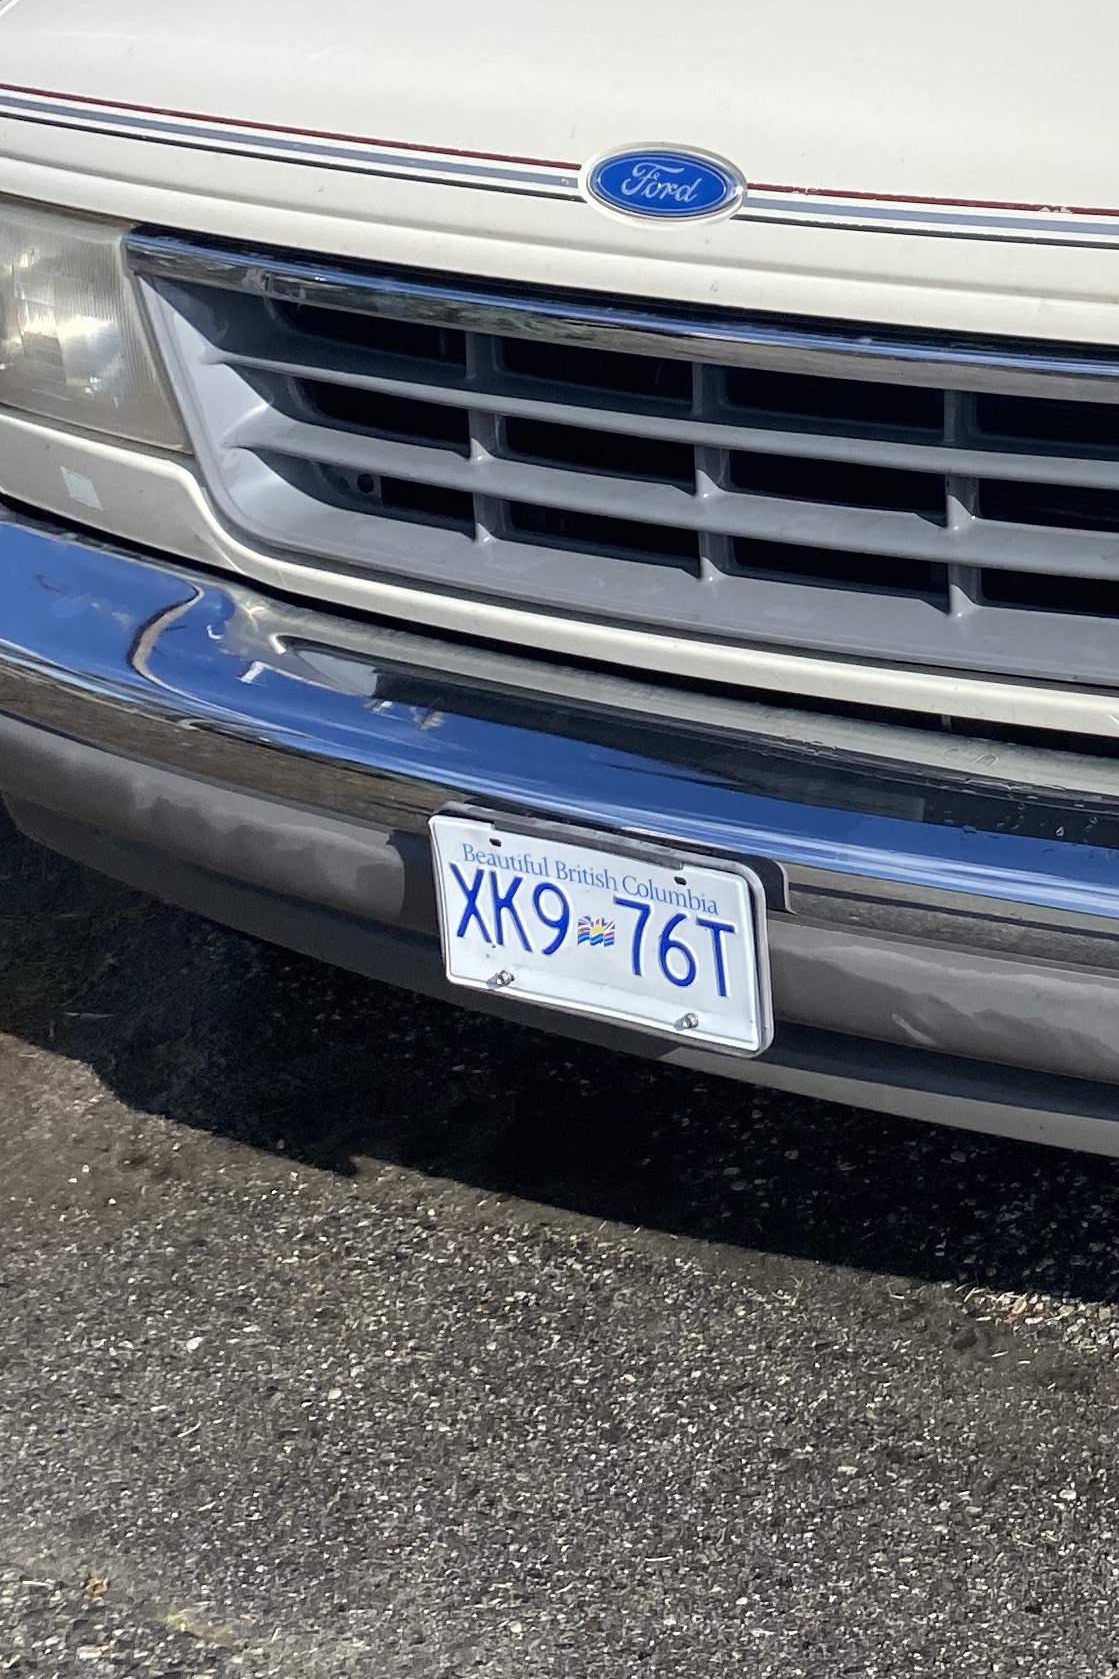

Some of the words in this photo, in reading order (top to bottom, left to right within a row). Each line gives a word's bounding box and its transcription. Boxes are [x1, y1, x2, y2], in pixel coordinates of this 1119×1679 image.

[621, 162, 702, 203] Ford
[461, 842, 549, 878] Beautiful
[555, 860, 617, 892] British
[622, 875, 719, 916] Columbia
[450, 861, 572, 956] XK9
[612, 895, 737, 999] 76T
